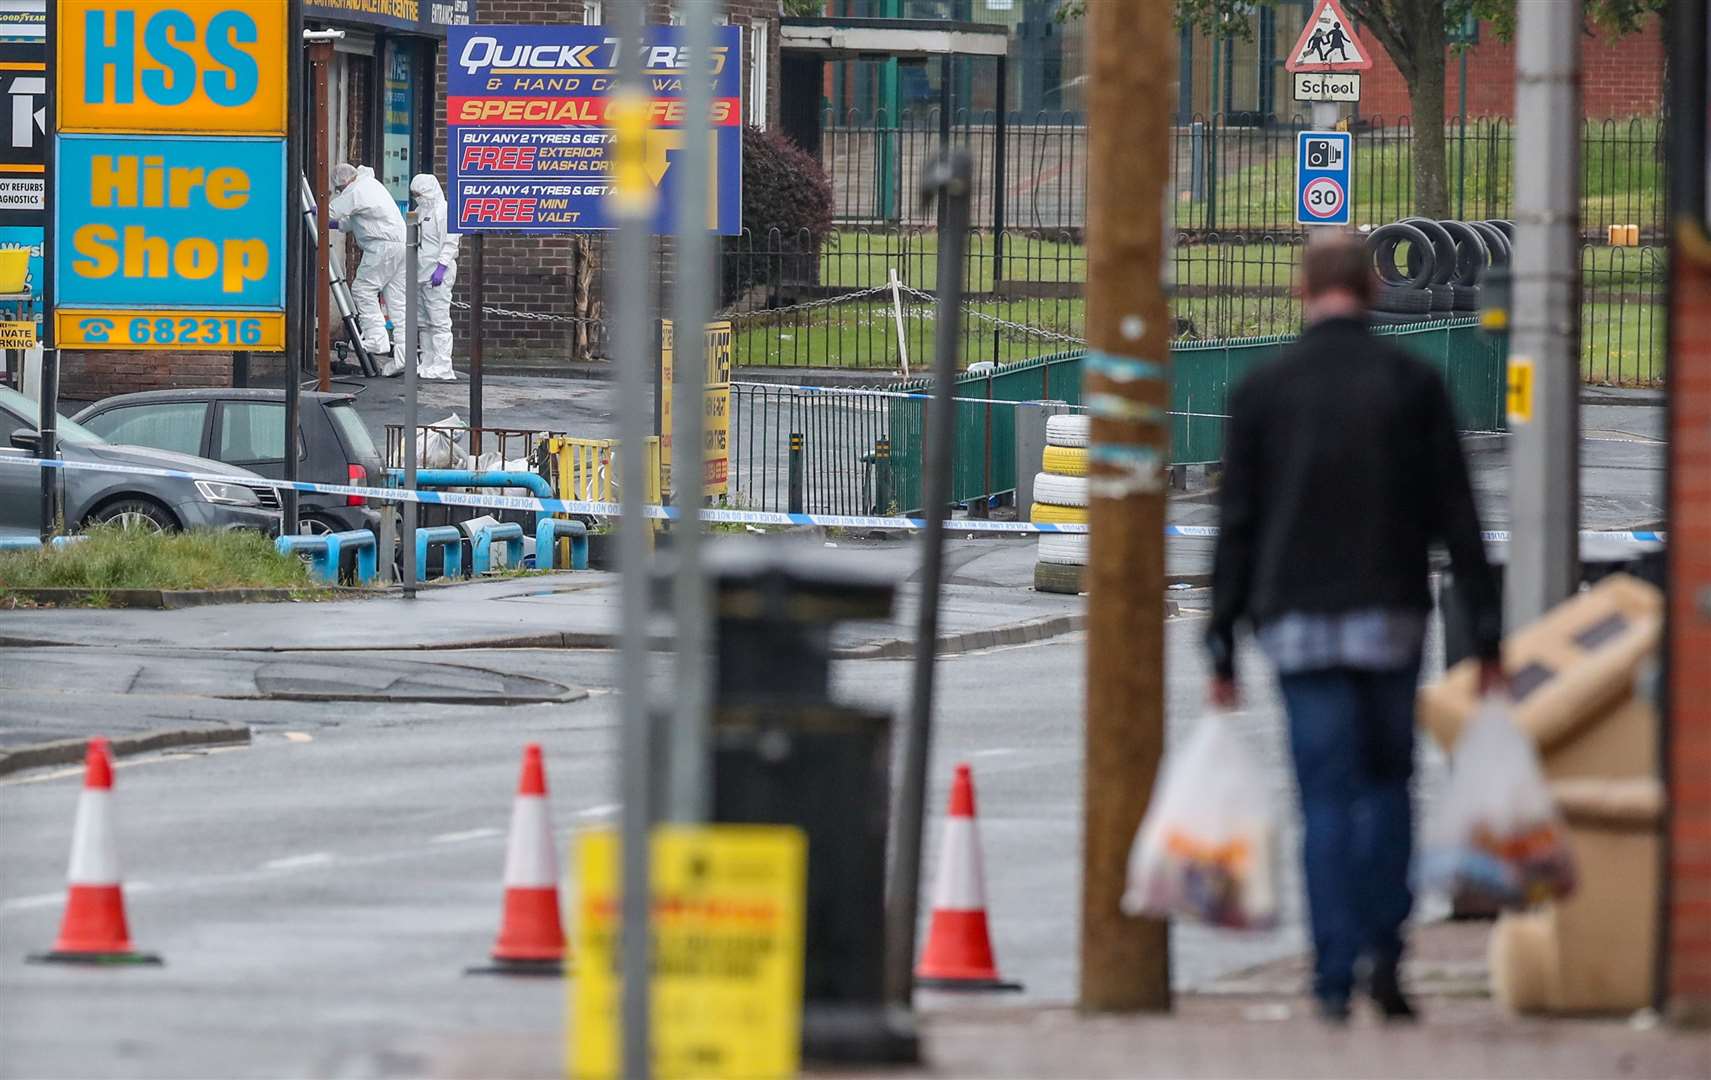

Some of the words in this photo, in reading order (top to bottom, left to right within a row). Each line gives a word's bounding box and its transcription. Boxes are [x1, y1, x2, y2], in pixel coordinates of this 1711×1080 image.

[84, 9, 259, 107] HSS
[486, 78, 503, 91] &
[514, 78, 581, 91] HAND
[1301, 80, 1354, 94] School
[460, 100, 598, 121] SPECIAL
[463, 133, 491, 144] BUY
[491, 133, 520, 144] ANY
[520, 133, 529, 144] 2
[531, 133, 571, 144] TYRES
[571, 133, 581, 144] &
[582, 134, 608, 144] GET
[461, 146, 538, 171] FREE
[538, 147, 604, 158] EXTERIOR
[537, 160, 578, 171] WASH
[578, 160, 588, 171] &
[11, 182, 43, 192] REFURBS
[90, 155, 251, 210] Hire
[463, 185, 492, 196] BUY
[491, 185, 520, 196] ANY
[520, 185, 529, 196] 4
[531, 185, 571, 196] TYRES
[571, 185, 581, 196] &
[583, 186, 608, 196] GET
[1310, 189, 1337, 206] 30
[461, 197, 538, 223] FREE
[539, 199, 568, 209] MINI
[537, 212, 580, 223] VALET
[72, 224, 269, 293] Shop
[128, 318, 261, 344] 682316
